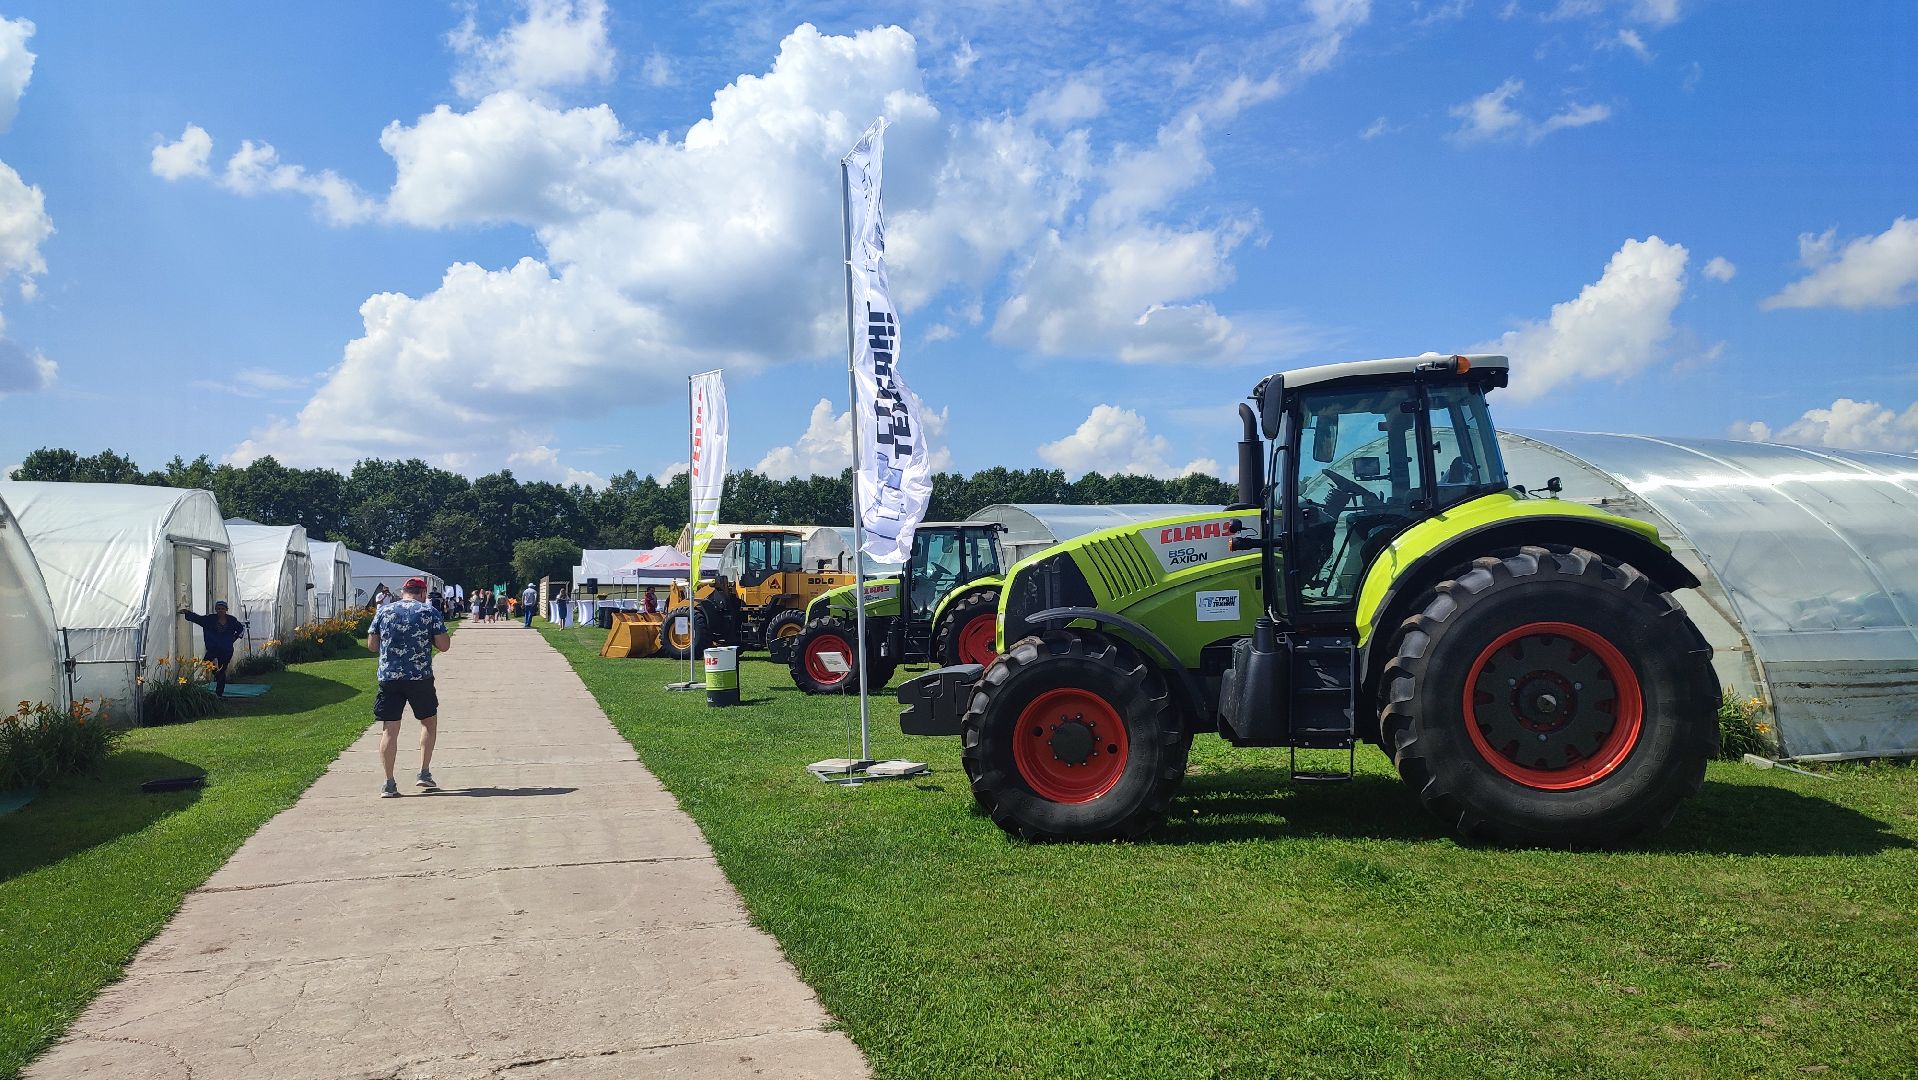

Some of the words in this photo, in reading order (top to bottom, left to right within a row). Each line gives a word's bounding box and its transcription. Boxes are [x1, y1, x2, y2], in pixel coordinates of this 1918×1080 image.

[1160, 521, 1235, 545] CLAAS
[1168, 547, 1195, 559] 850
[1170, 552, 1208, 566] AXION
